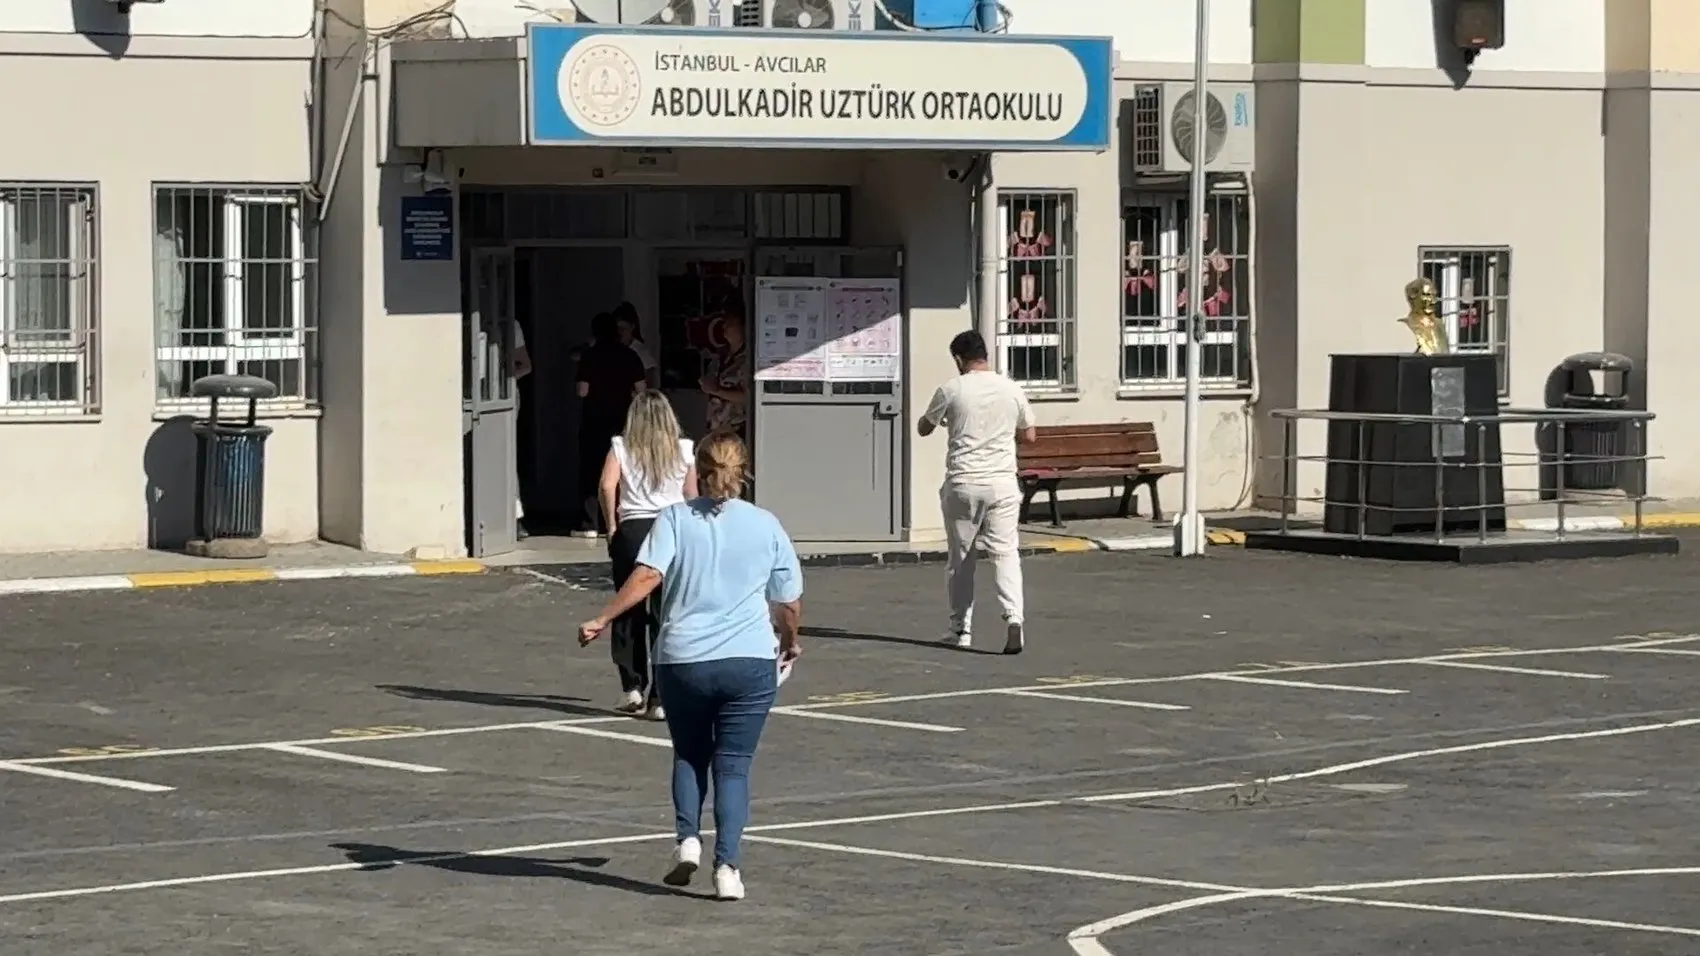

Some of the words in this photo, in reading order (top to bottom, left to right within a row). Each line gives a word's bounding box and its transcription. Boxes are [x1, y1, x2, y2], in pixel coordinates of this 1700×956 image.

[655, 50, 740, 72] İSTANBUL
[754, 56, 827, 73] AVCILAR
[651, 81, 813, 118] ABDULKADİR
[820, 83, 916, 119] UZTÜRK
[921, 91, 1063, 121] ORTAOKULU
